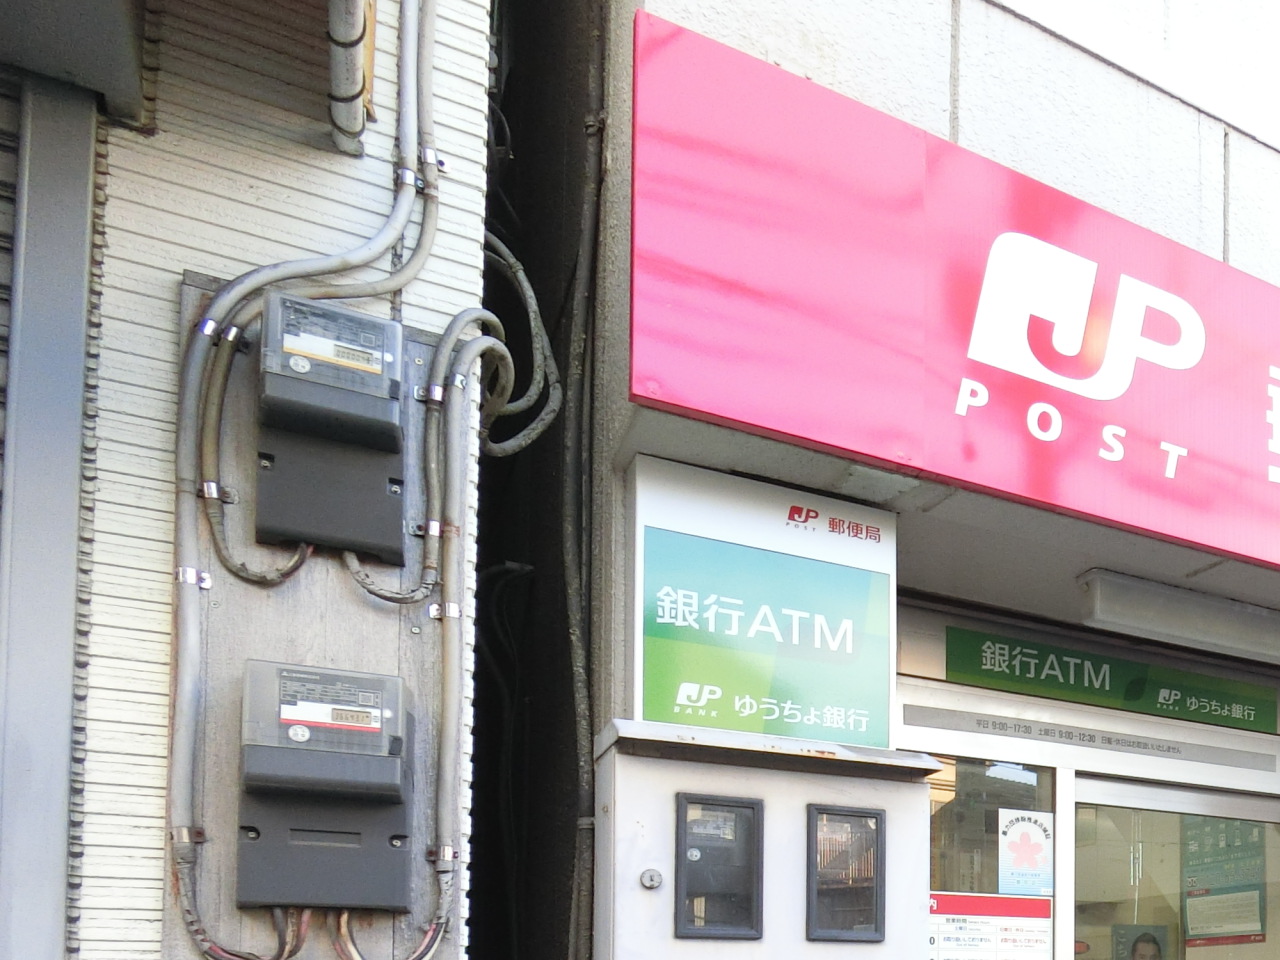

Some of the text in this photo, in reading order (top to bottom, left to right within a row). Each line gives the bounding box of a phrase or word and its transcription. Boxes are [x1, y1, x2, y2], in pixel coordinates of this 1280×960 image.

[967, 231, 1207, 401] JP
[954, 377, 1188, 480] POST
[787, 505, 819, 524] JP
[828, 517, 881, 543] 郵便局
[656, 585, 854, 655] 銀行ATM
[981, 640, 1111, 691] 銀行ATM
[676, 682, 722, 706] JP
[1158, 688, 1181, 704] JP
[674, 706, 718, 717] BANK
[734, 695, 870, 732] ゆうちょ銀行
[1186, 696, 1256, 721] ゆうちょ銀行
